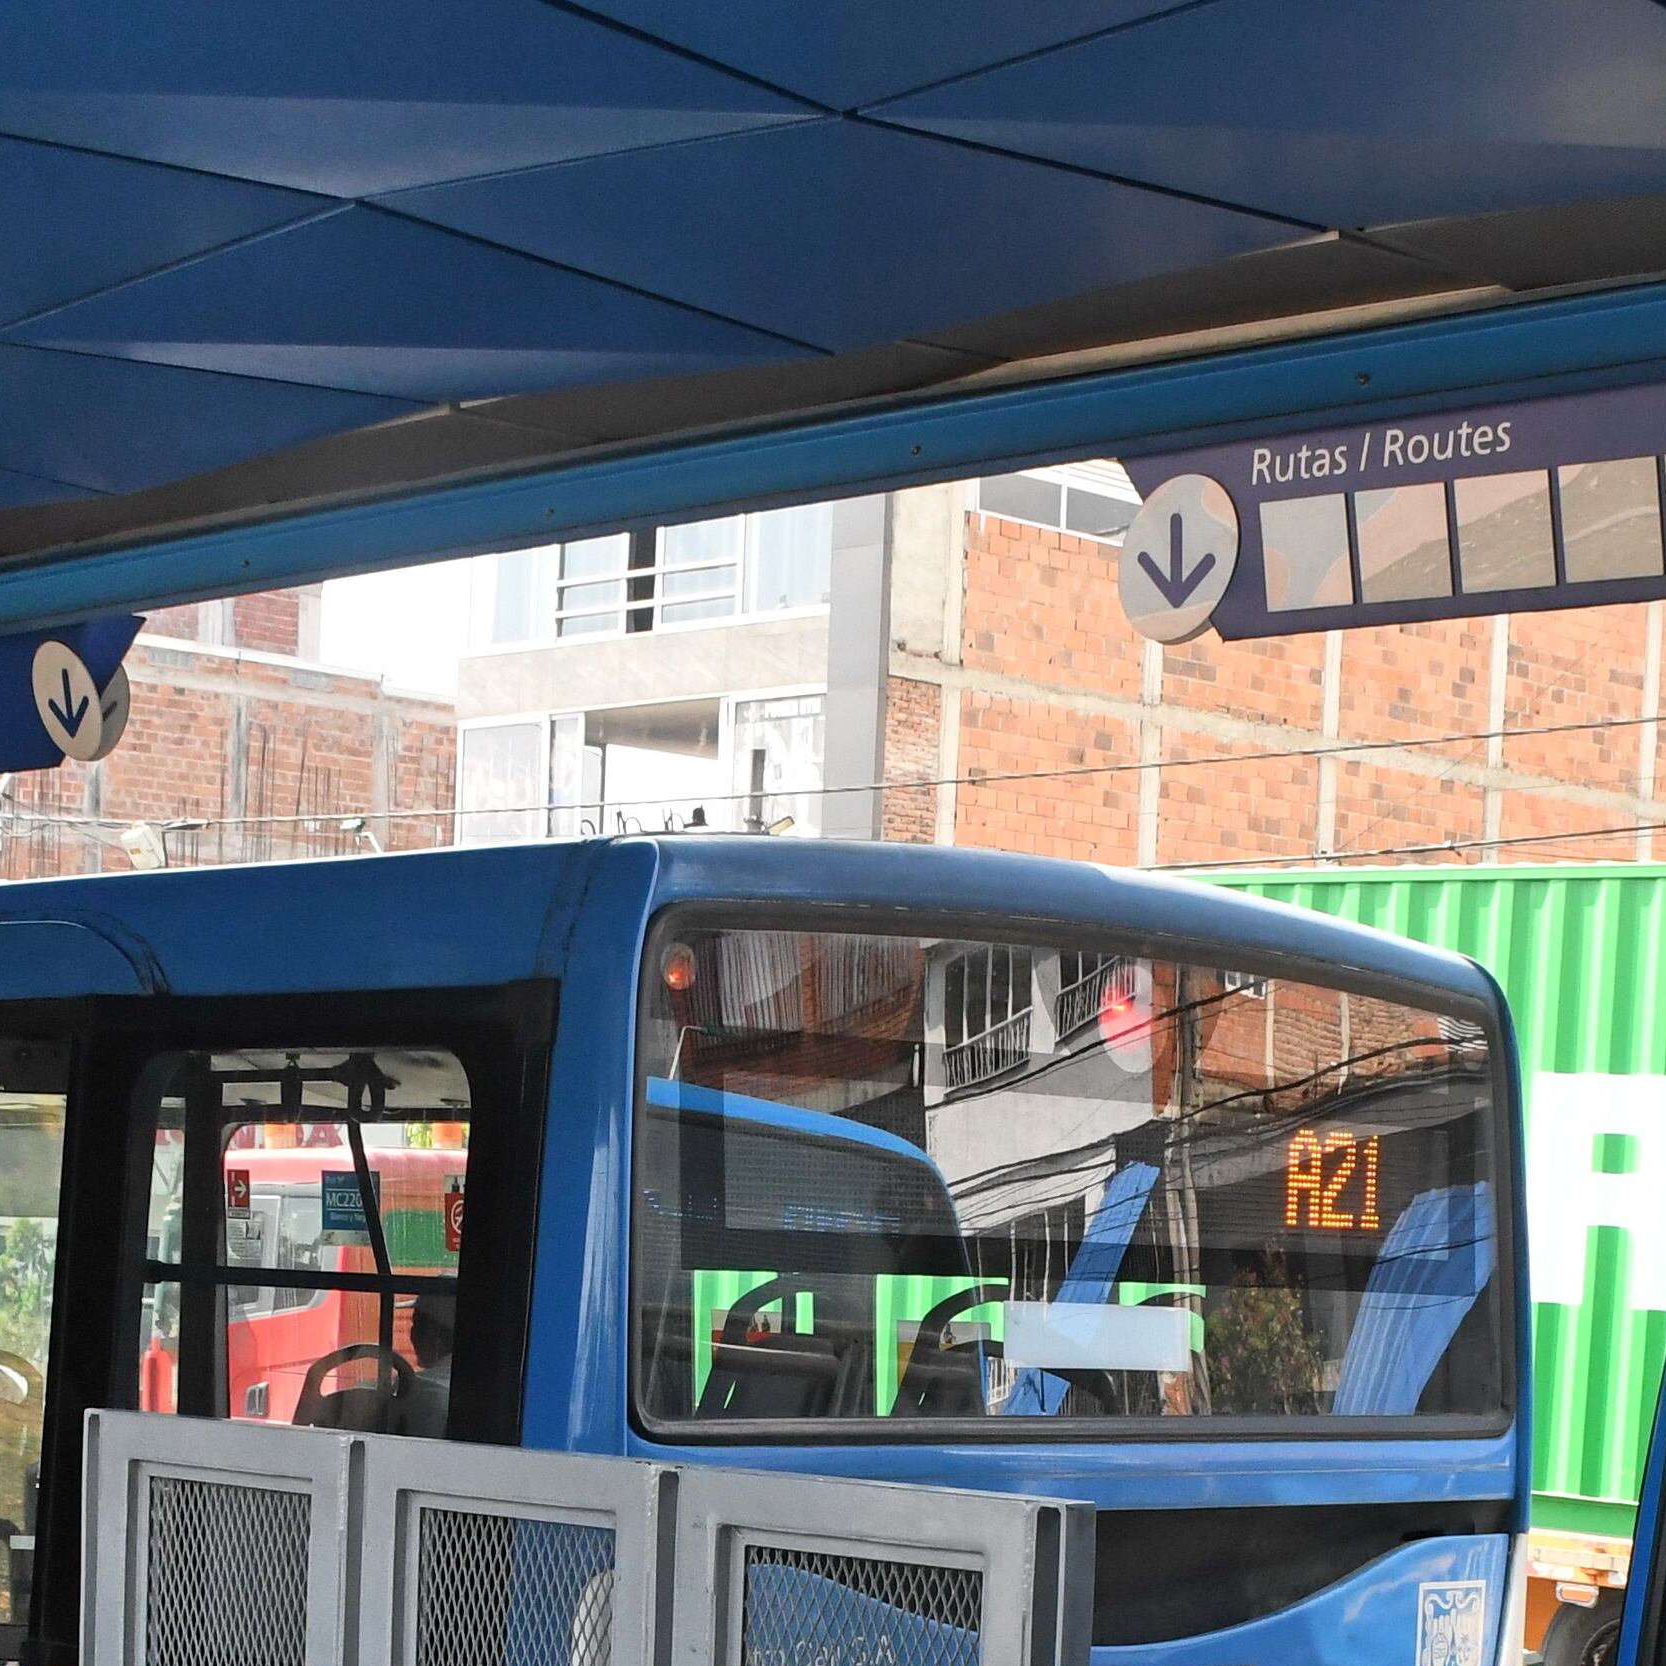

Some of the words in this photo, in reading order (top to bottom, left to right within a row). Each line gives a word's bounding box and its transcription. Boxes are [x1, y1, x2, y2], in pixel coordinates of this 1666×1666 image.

[1251, 444, 1348, 486] Rutas
[1359, 432, 1371, 472] /
[1383, 420, 1512, 468] Routes
[325, 1191, 364, 1208] MC220
[1286, 1128, 1380, 1228] A21
